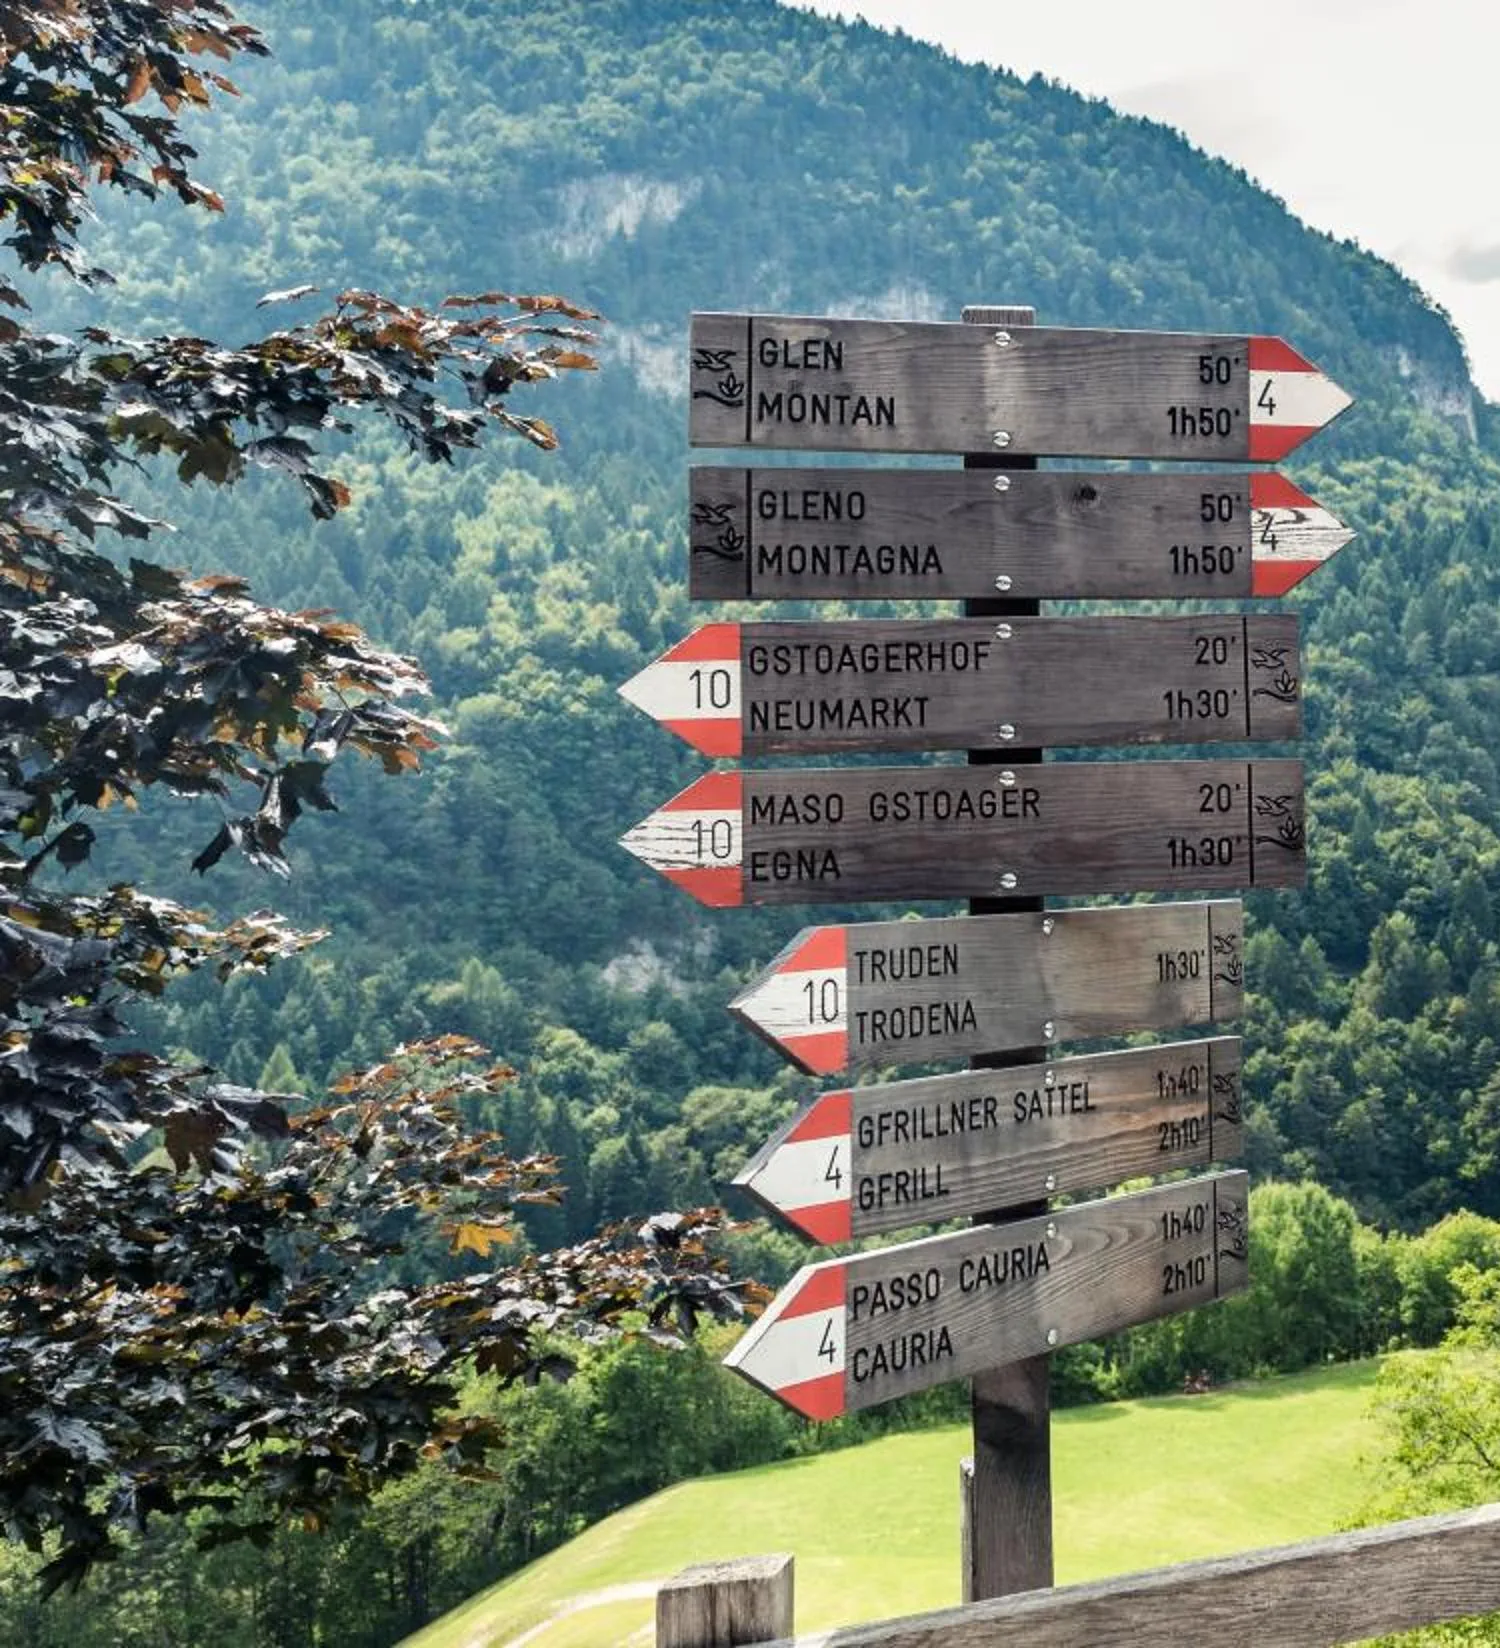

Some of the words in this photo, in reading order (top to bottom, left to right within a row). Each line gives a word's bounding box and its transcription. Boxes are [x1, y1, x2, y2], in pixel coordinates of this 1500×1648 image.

[758, 339, 844, 371] GLEN
[757, 394, 896, 428] MONTAN
[1257, 378, 1277, 417] 4
[758, 490, 867, 521] GLENO
[1260, 513, 1278, 553] 4
[757, 545, 943, 576] MONTAGNA
[749, 641, 991, 677] GSTOAGERHOF
[688, 669, 731, 709] 10
[751, 697, 929, 731] NEUMARKT
[752, 792, 844, 825] MASO
[869, 787, 1041, 822] GSTOAGER
[691, 819, 732, 859] 10
[752, 850, 841, 881] EGNA
[855, 944, 958, 984] TRUDEN
[802, 978, 839, 1024] 10
[856, 1000, 977, 1044] TRODENA
[858, 1097, 998, 1149] GFRILLNER
[1013, 1082, 1097, 1122] SATTEL
[825, 1144, 841, 1191] 4
[859, 1164, 950, 1211] GFRILL
[853, 1269, 941, 1322] PASSO
[959, 1241, 1051, 1293] CAURIA
[817, 1319, 836, 1364] 4
[853, 1325, 954, 1383] CAURIA
